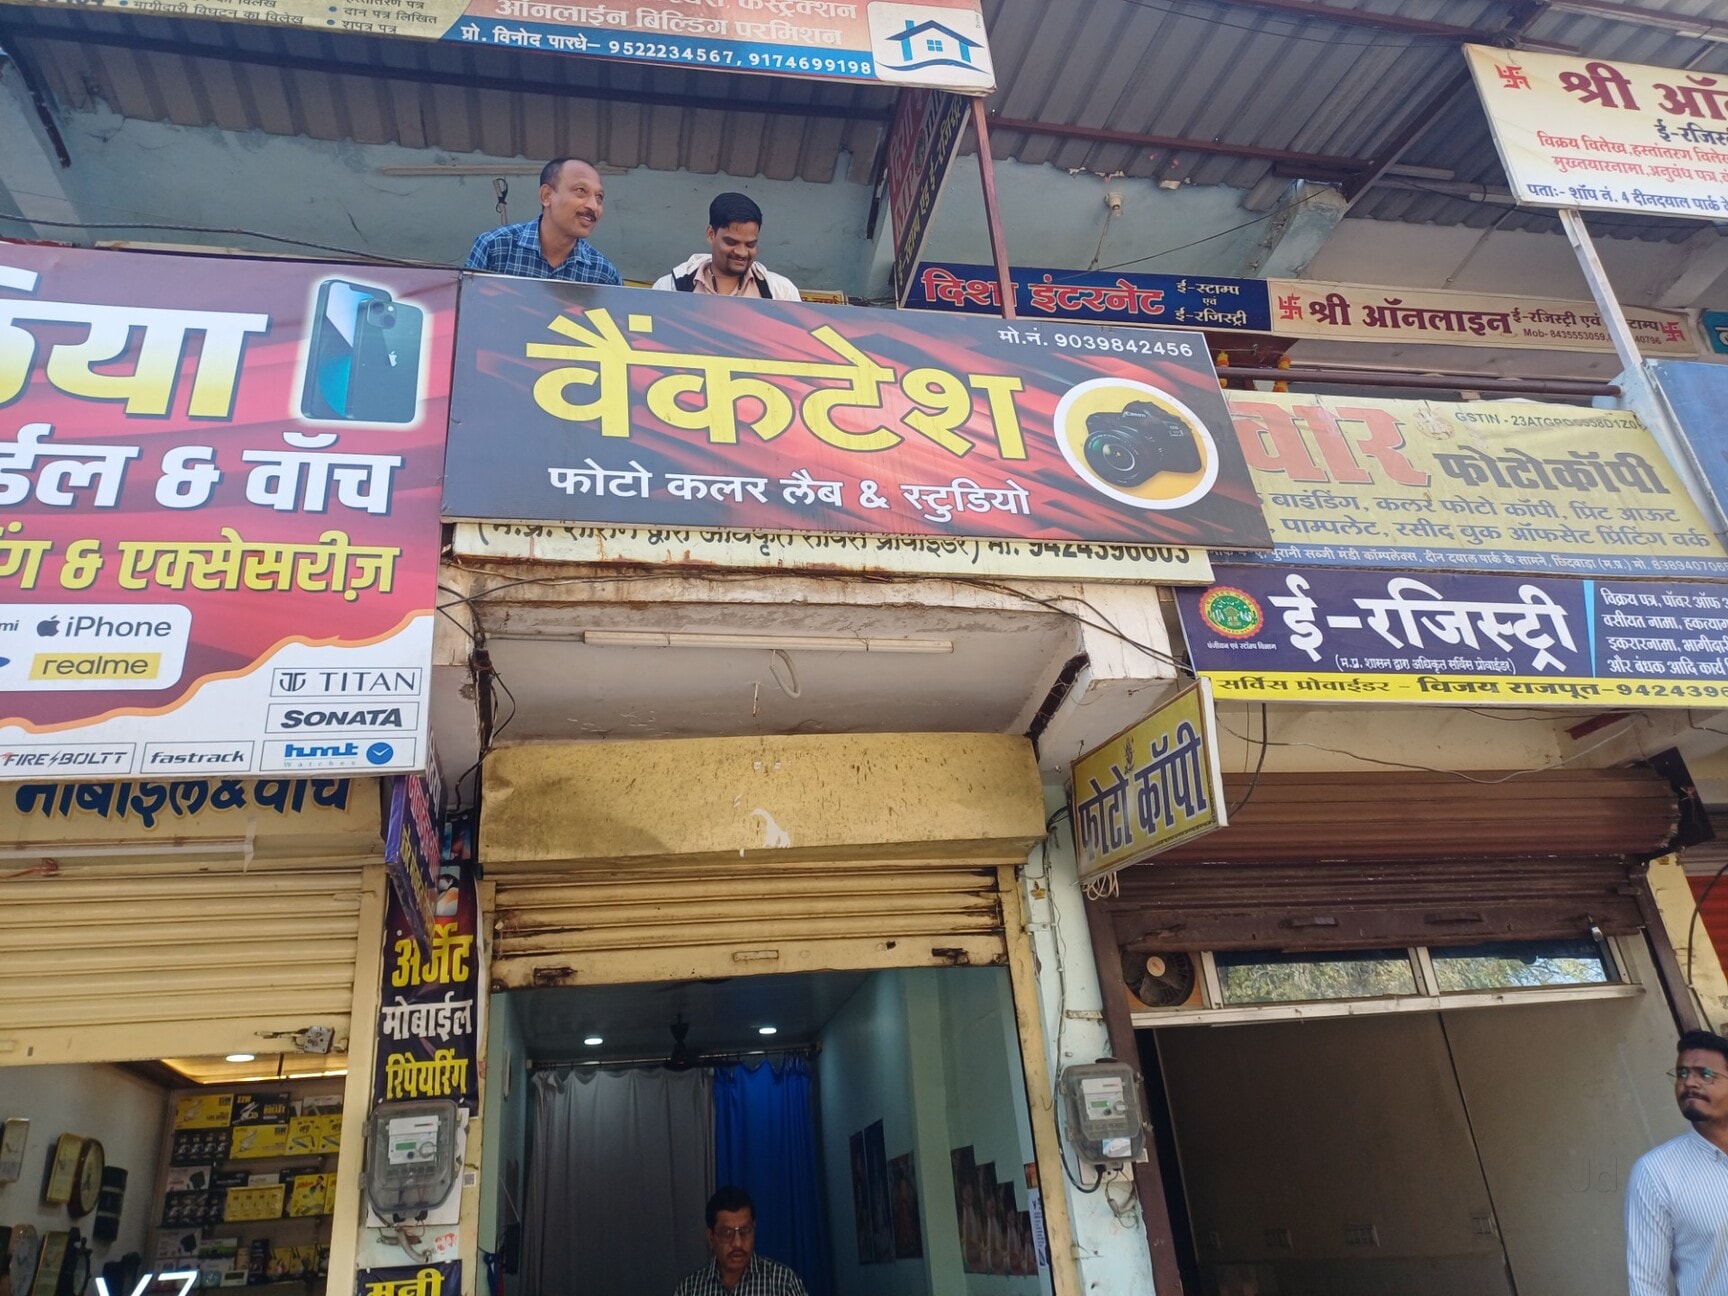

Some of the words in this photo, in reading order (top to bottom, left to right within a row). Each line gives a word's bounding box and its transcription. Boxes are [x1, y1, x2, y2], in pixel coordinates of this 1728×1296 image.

[243, 10, 260, 20] का
[266, 11, 304, 24] विलेख
[372, 9, 391, 20] पत्र
[396, 10, 437, 24] लिखित
[378, 24, 397, 34] पत्र
[735, 19, 844, 46] परमिशन
[460, 23, 487, 42] प्रो.
[493, 26, 542, 47] विनोद
[608, 40, 742, 66] 9522234567,
[749, 53, 871, 75] 9174699198
[1558, 62, 1641, 111] श्री
[1652, 75, 1728, 121] ऑ
[1536, 130, 1579, 149] विक्रय
[1653, 118, 1728, 146] ई-रजिस्
[1568, 185, 1598, 201] शॉप
[1621, 191, 1629, 204] 4
[1631, 188, 1689, 209] दीनदयाल
[1691, 194, 1721, 211] पार्क
[1028, 273, 1165, 315] इंटरनेट
[1176, 279, 1240, 296] ई-स्टाम्प
[1202, 296, 1218, 307] एवं
[1308, 292, 1352, 326] श्री
[1362, 298, 1511, 335] ऑनलाइन
[1510, 307, 1577, 327] ई-रजिस्ट्री
[1579, 312, 1601, 327] एवं
[1174, 306, 1248, 327] ई-रजिस्ट्री
[1054, 332, 1193, 357] 9039842456
[525, 307, 1028, 460] वैंकटेश
[1455, 411, 1501, 425] GSTIN
[154, 446, 221, 509] &
[241, 432, 403, 515] वॉच
[1433, 444, 1671, 494] फोटोकॉपी
[548, 458, 652, 498] फोटो
[665, 472, 768, 504] कलर
[779, 468, 843, 507] लैब
[859, 479, 891, 509] &
[900, 477, 1031, 522] स्टुडियो
[1373, 496, 1436, 513] कलर
[1440, 495, 1498, 515] फोटो
[1569, 500, 1613, 521] प्रिंट
[1617, 507, 1681, 522] आऊट
[1392, 518, 1455, 539] रसीद
[1457, 523, 1502, 545] बुक
[1507, 522, 1597, 545] ऑफसेट
[1597, 525, 1667, 546] प्रिंटिंग
[1668, 528, 1711, 547] वर्क
[59, 538, 104, 589] &
[118, 527, 401, 601] एक्सेसरीज़
[1338, 547, 1360, 561] मंडी
[1424, 549, 1445, 563] दीन
[1447, 552, 1476, 564] दयाल
[1478, 551, 1501, 564] पार्क
[1503, 552, 1515, 565] के
[1600, 587, 1638, 606] विक्रय
[1661, 590, 1693, 608] पॉवर
[1692, 592, 1721, 609] ऑफ
[65, 615, 172, 638] iPhone
[1268, 573, 1579, 674] ई-रजिस्ट्री
[1601, 610, 1647, 628] वसीयत
[42, 655, 148, 675] realme
[1364, 657, 1391, 670] शासन
[1411, 655, 1447, 674] अधिकृत
[1607, 654, 1634, 673] और
[1632, 656, 1666, 674] बंधक
[1666, 656, 1699, 675] आदि
[1696, 658, 1726, 675] कार्य
[319, 672, 416, 692] TITAN
[1216, 675, 1288, 691] सर्विस
[1295, 677, 1391, 693] प्रोवाईडर
[1417, 675, 1499, 695] विजय
[280, 708, 403, 729] SONATA
[150, 751, 245, 765] fastrack
[1078, 765, 1133, 861] फोटो
[1134, 721, 1207, 835] कॉपी
[381, 991, 473, 1042] मोबाईल
[386, 1048, 469, 1100] रिपेयरिंग
